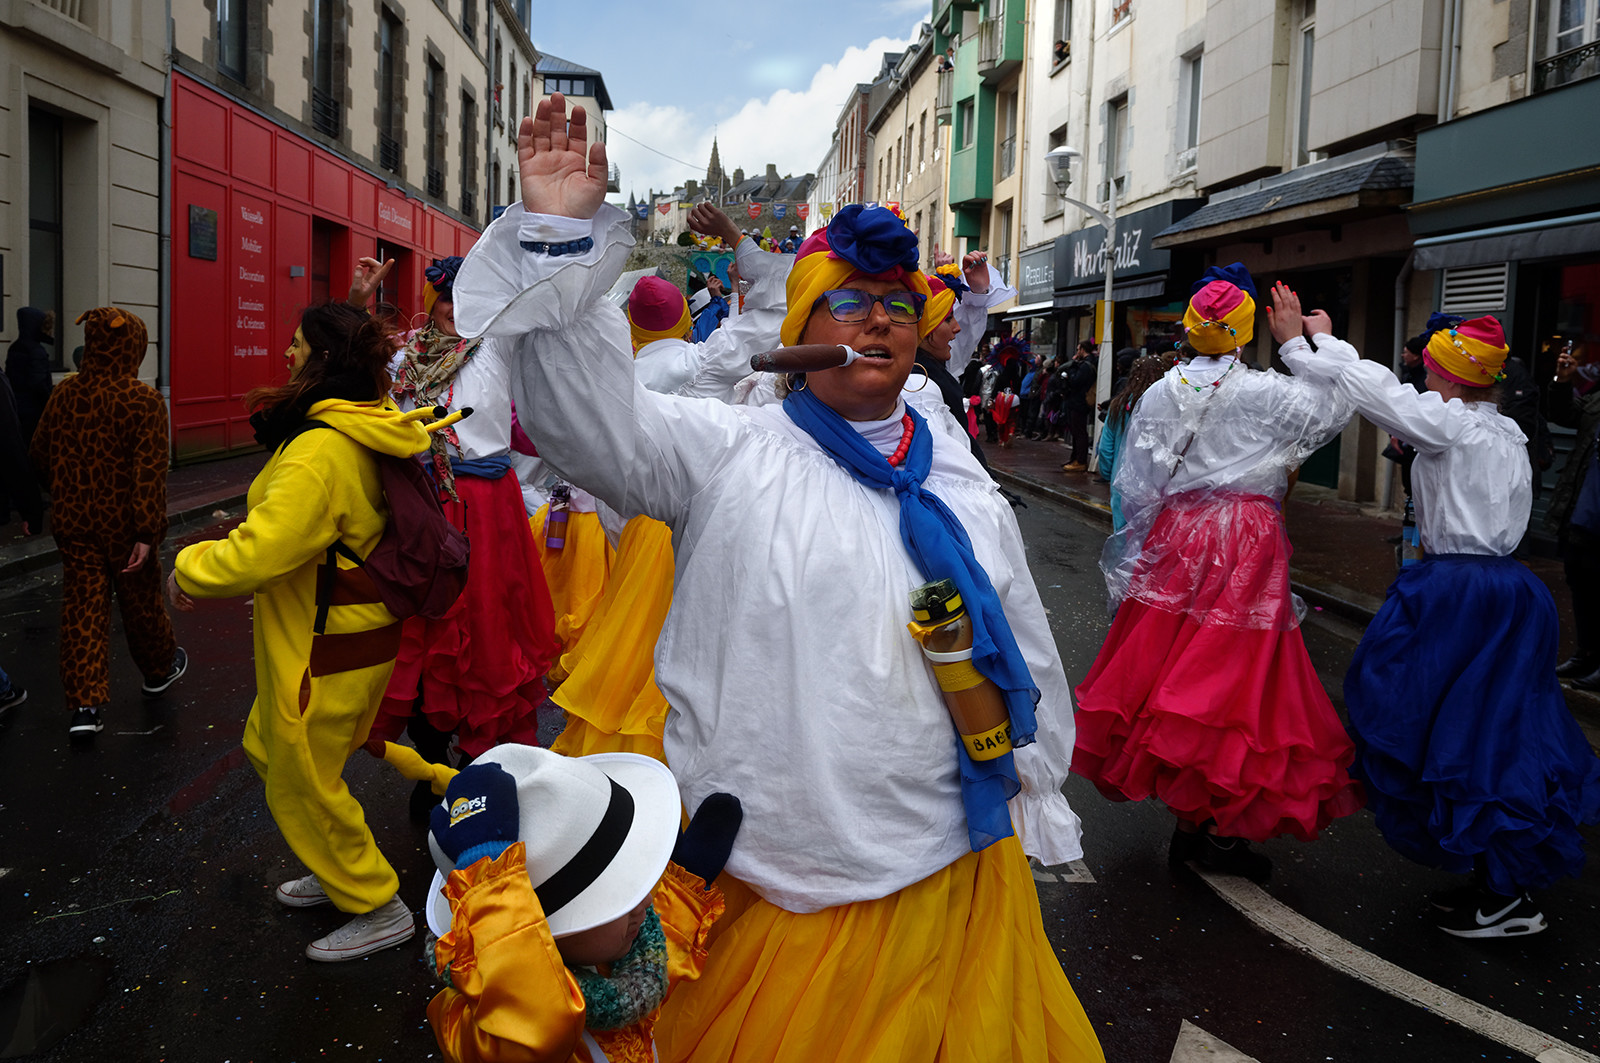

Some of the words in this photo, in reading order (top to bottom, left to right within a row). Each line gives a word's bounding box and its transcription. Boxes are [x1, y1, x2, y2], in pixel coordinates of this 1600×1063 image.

[241, 206, 264, 225] Vaisselle
[242, 236, 262, 254] Mobilier
[240, 266, 265, 283] Décoration
[1025, 265, 1048, 287] REBELLE
[238, 296, 264, 311] Luminaires
[236, 315, 243, 329] de
[243, 315, 265, 330] Créateurs
[247, 345, 252, 356] de
[253, 345, 268, 356] Maison
